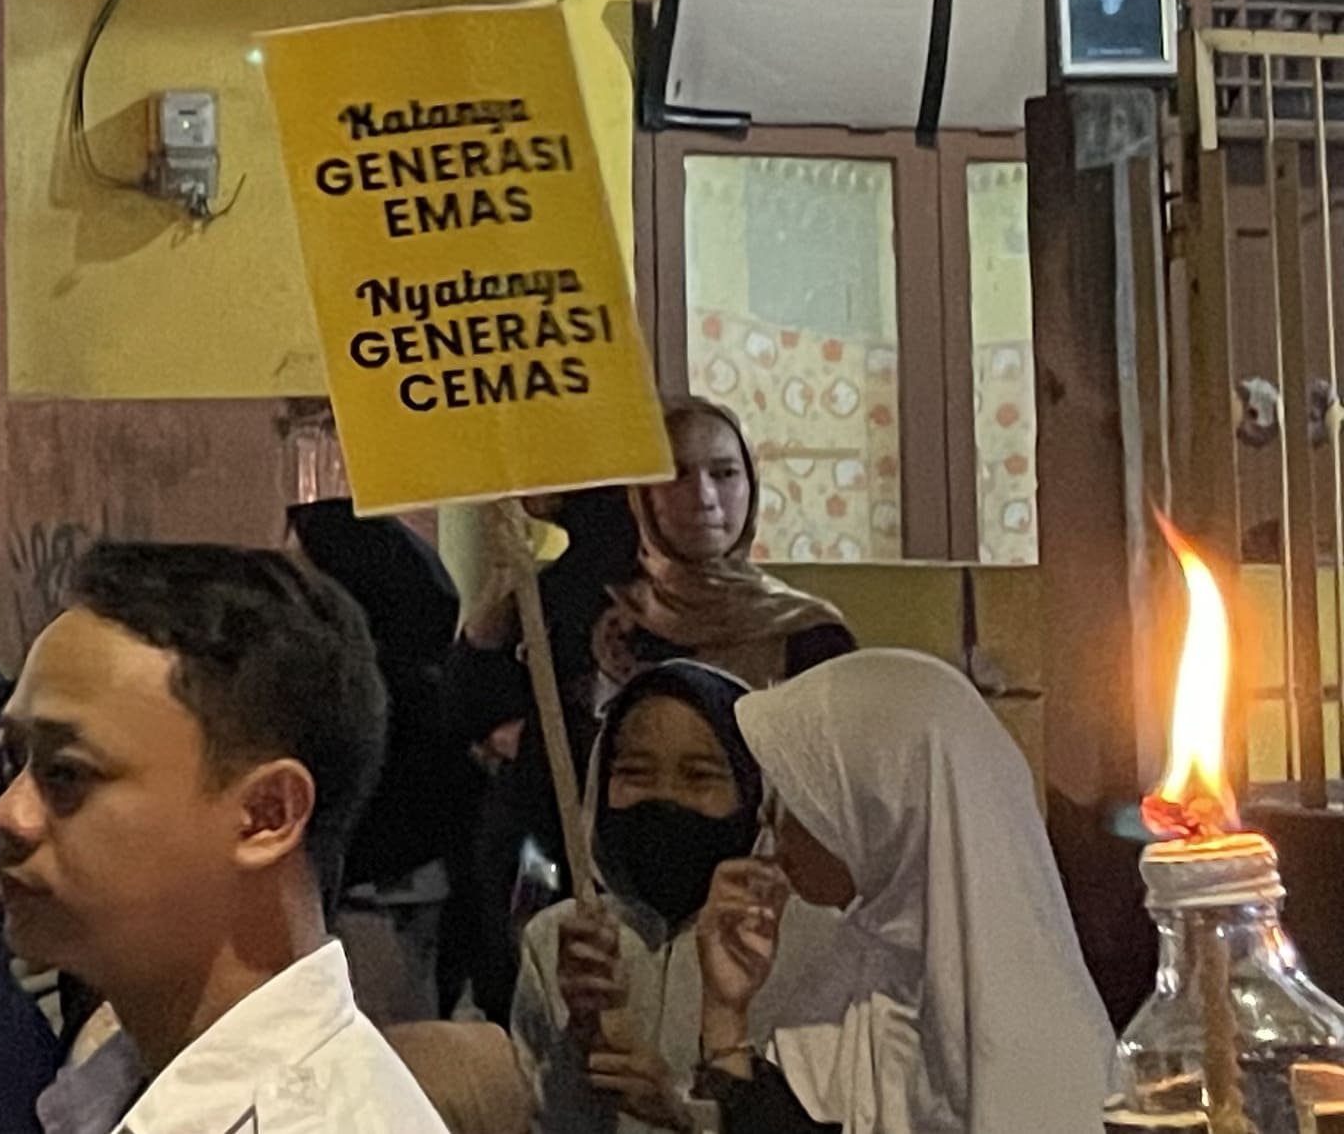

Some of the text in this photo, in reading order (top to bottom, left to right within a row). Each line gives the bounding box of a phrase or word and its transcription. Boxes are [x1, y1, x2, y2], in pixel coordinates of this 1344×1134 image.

[338, 97, 531, 141] Katanya
[315, 134, 574, 196] GENERASI
[383, 185, 533, 238] EMAS
[356, 268, 584, 322] Nyatanya
[350, 305, 612, 369] GENERASI
[399, 356, 591, 413] CEMAS
